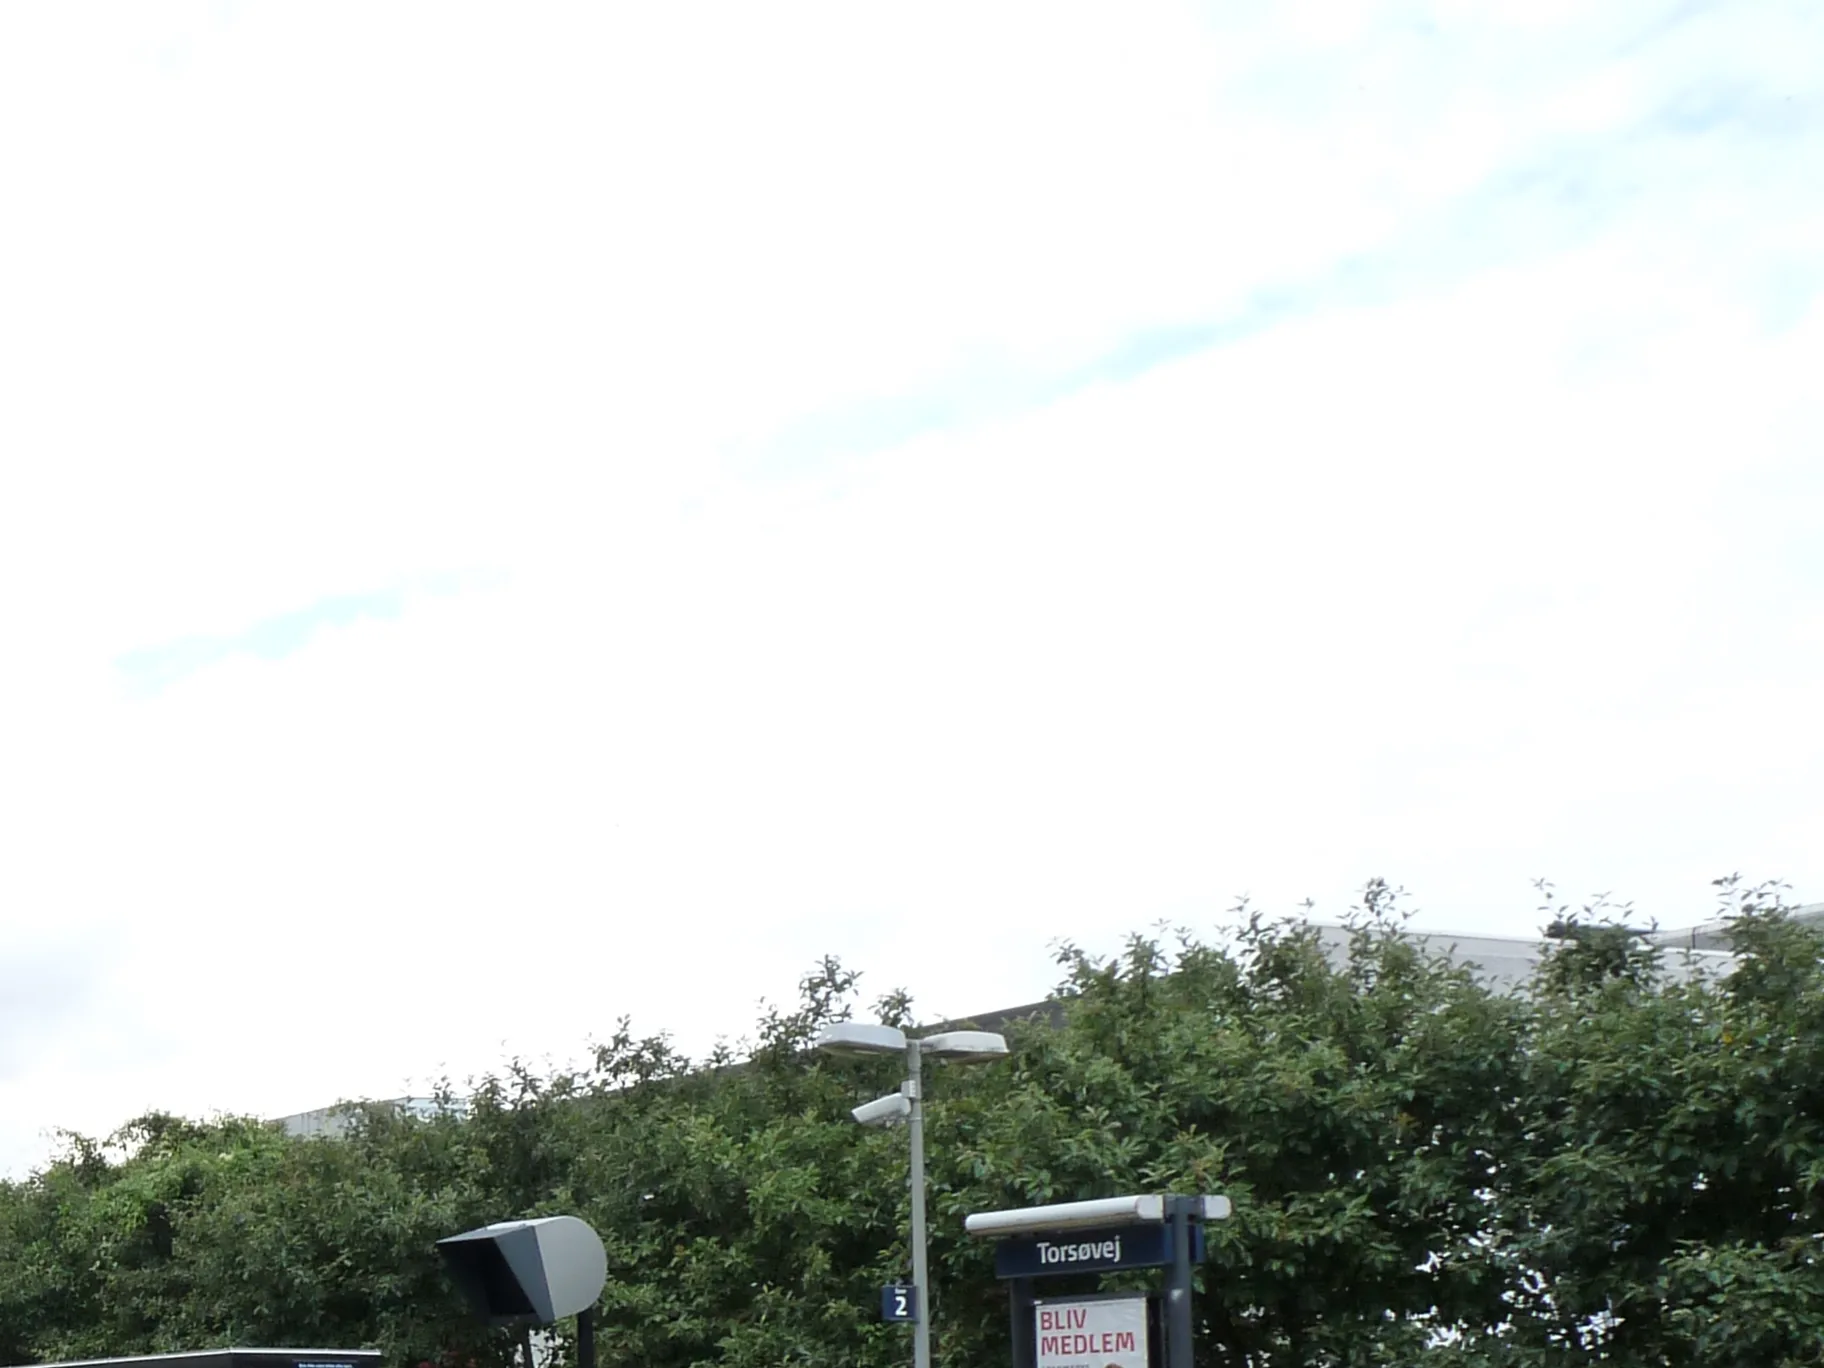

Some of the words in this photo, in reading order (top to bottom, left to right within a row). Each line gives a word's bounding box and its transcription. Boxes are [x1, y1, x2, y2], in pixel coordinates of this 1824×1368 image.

[1037, 1235, 1120, 1264] Torsøvej
[895, 1296, 907, 1316] 2
[1041, 1309, 1086, 1331] BLIV
[1041, 1332, 1135, 1356] MEDLEM
